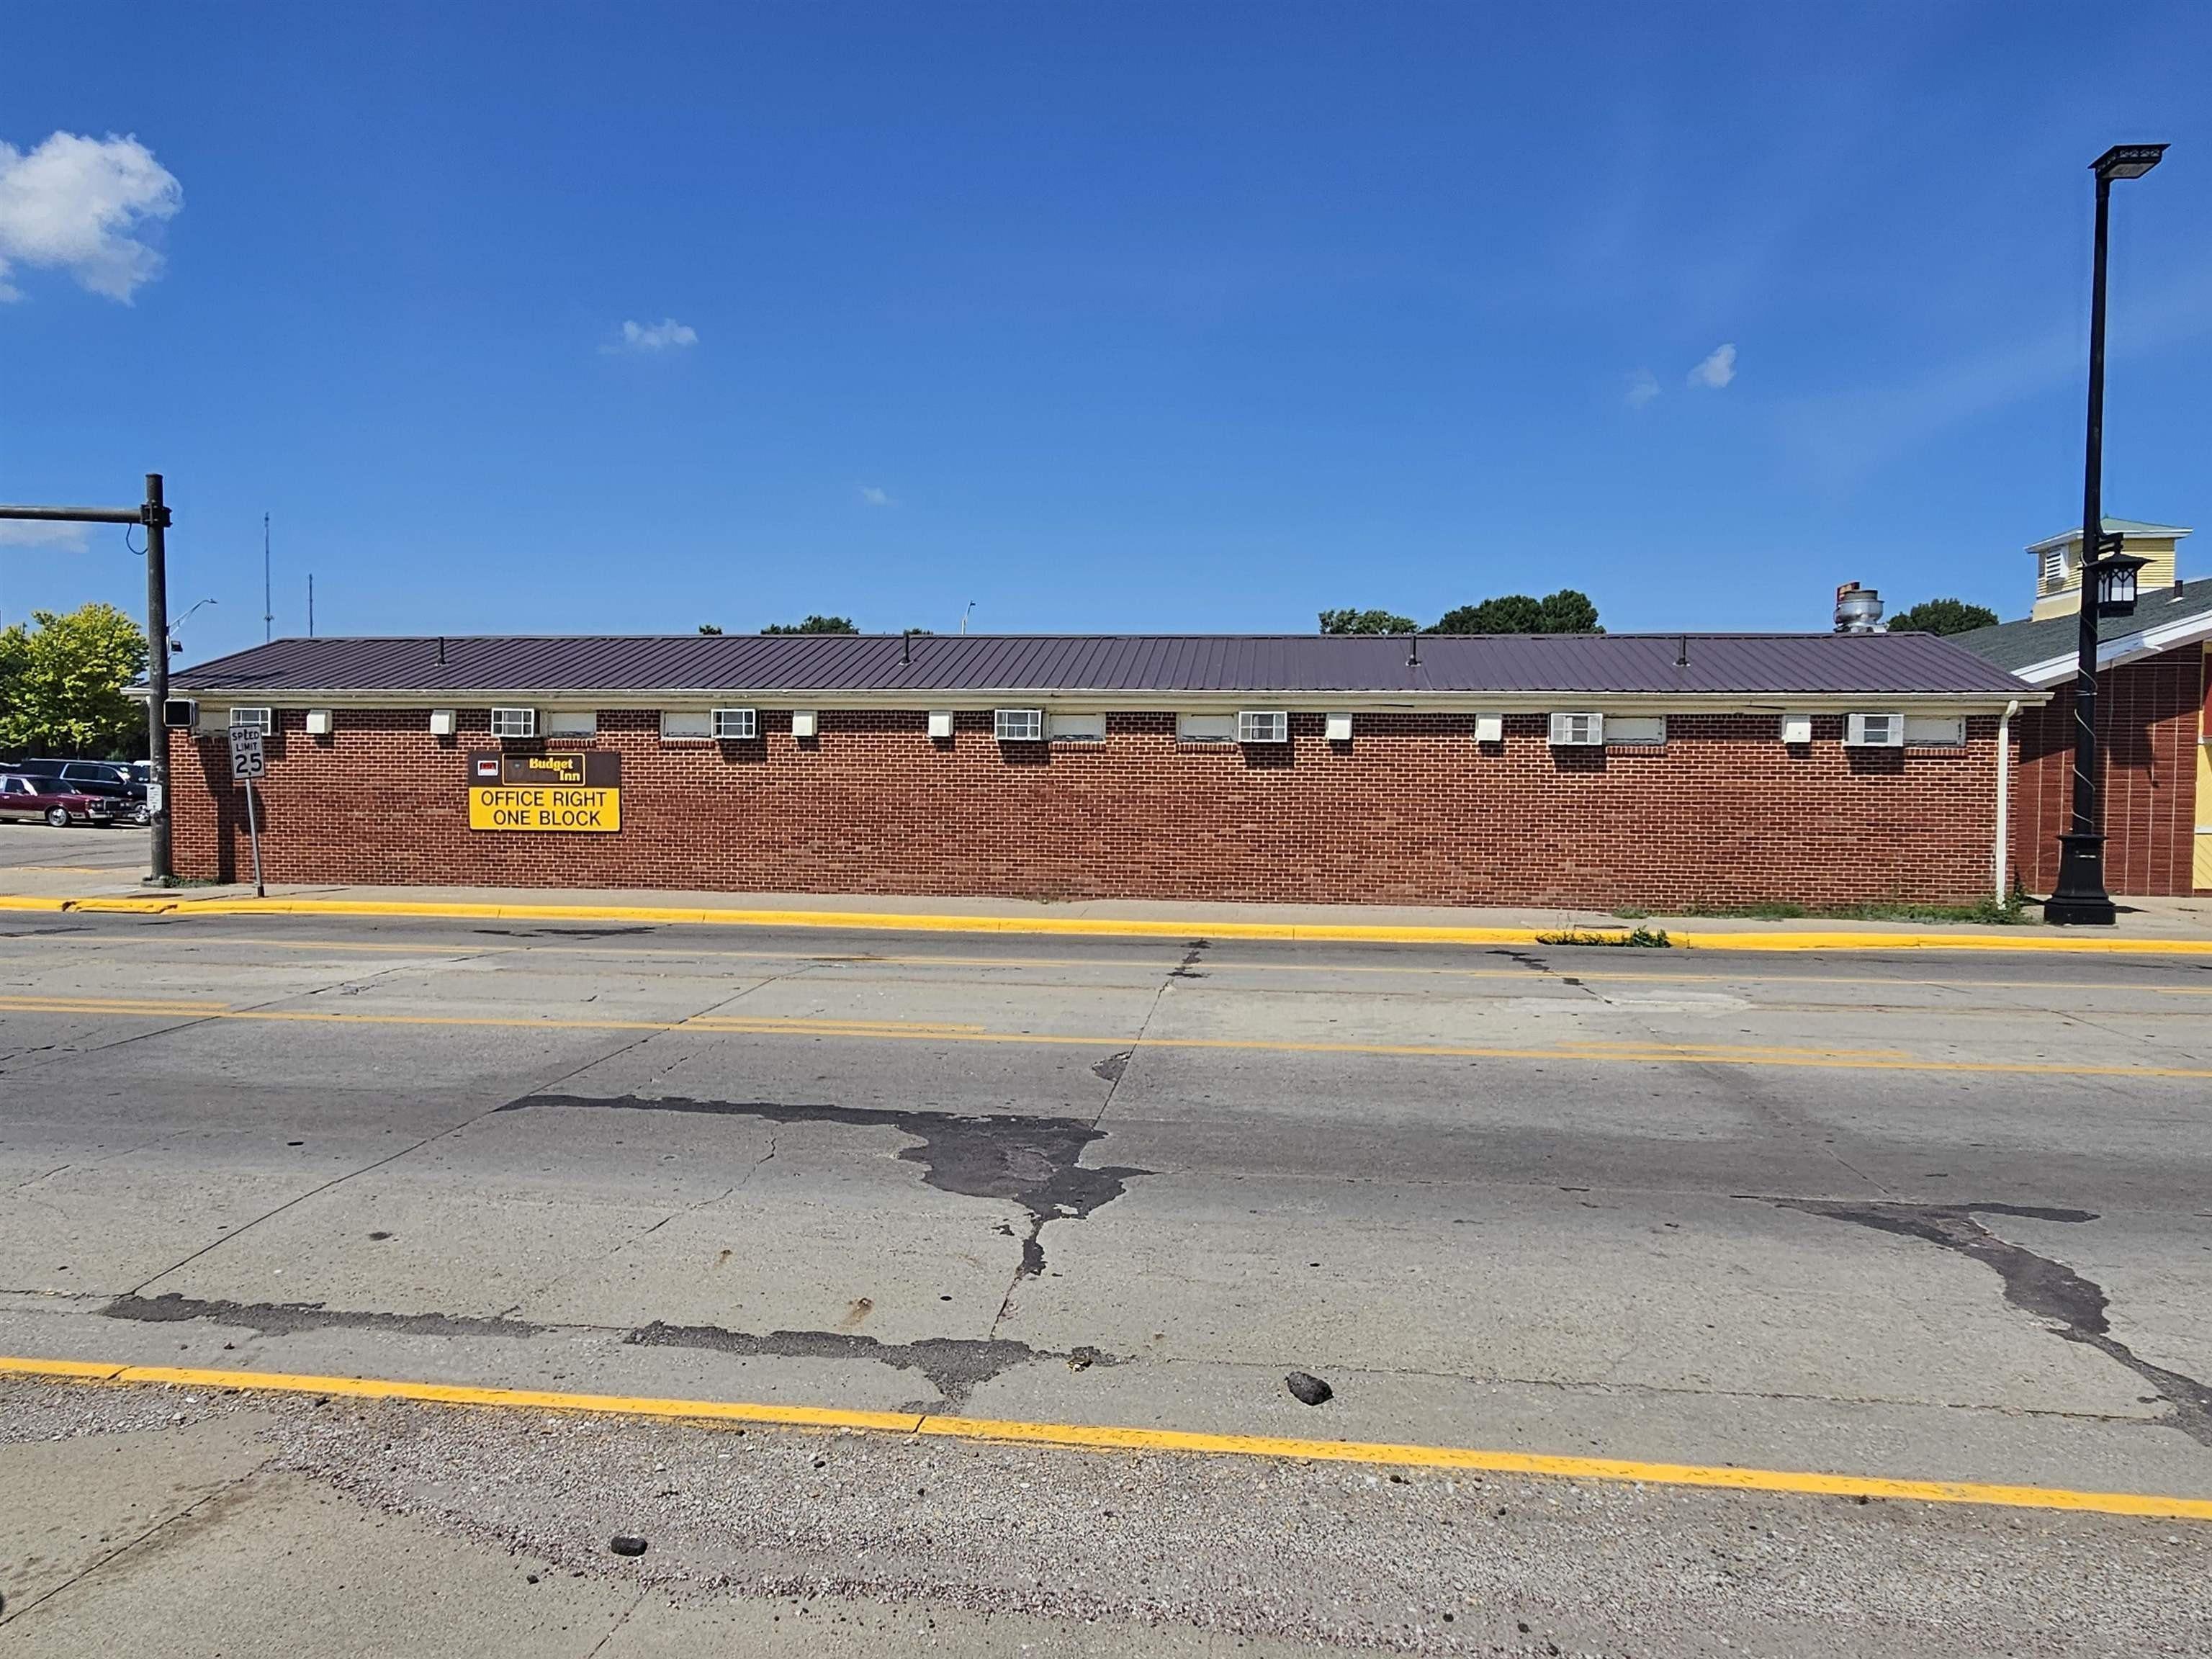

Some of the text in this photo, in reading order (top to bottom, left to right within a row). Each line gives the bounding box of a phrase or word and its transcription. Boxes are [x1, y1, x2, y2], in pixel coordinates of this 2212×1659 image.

[232, 730, 259, 741] SPEED
[236, 742, 257, 752] LIMIT
[235, 753, 262, 773] 25
[529, 757, 573, 771] Budget
[559, 770, 580, 781] Inn
[481, 791, 607, 806] OFFICE RIGHT
[493, 809, 601, 826] ONE BLOCK
